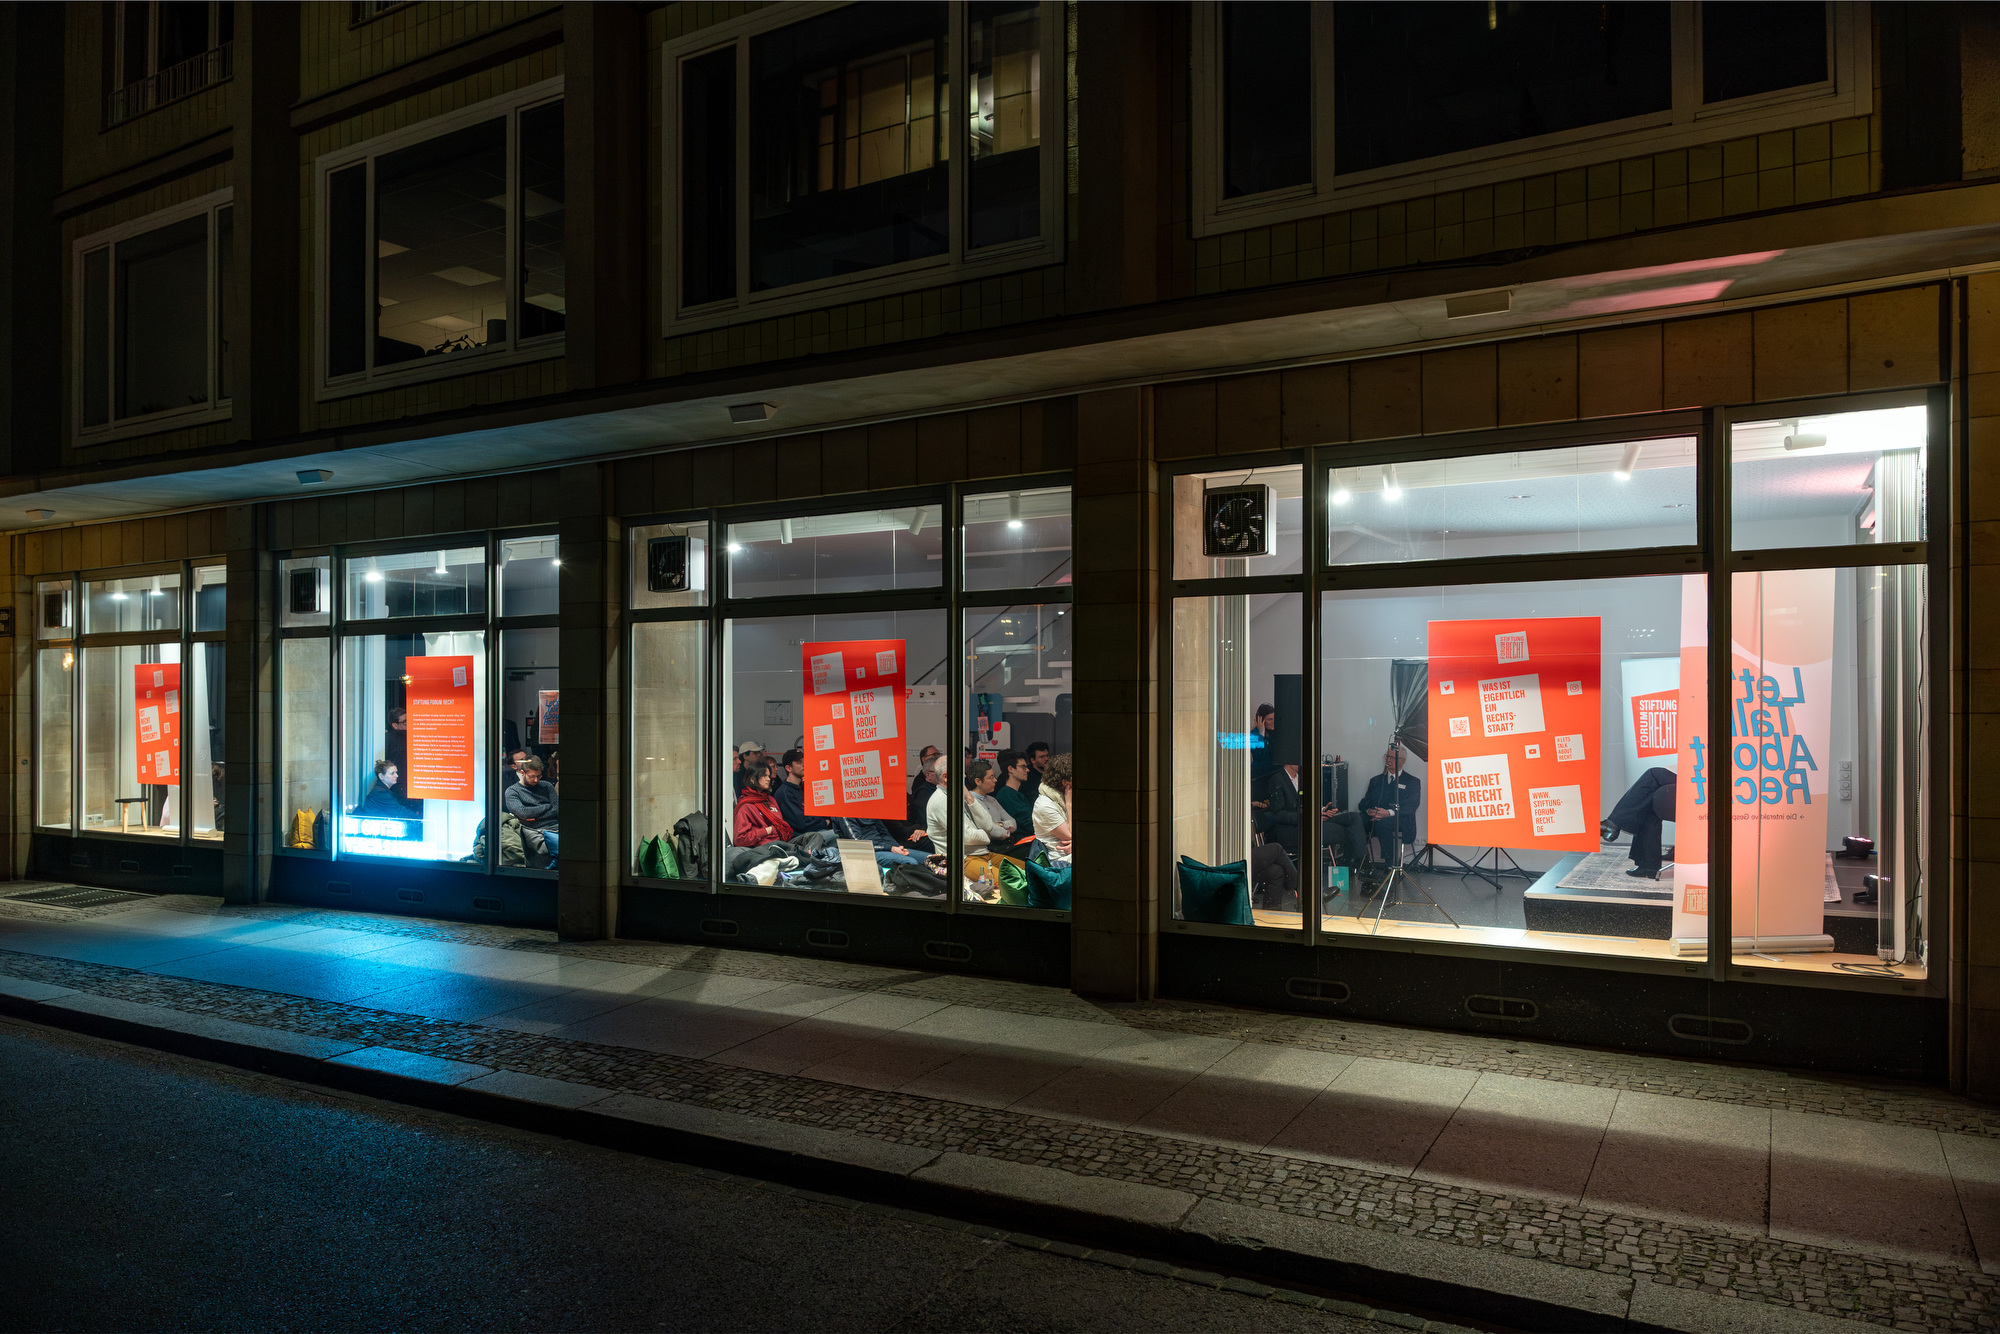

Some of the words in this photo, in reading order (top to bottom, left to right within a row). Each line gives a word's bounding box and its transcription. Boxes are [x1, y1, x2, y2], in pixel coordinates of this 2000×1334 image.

[1506, 641, 1525, 659] RECHT
[1482, 682, 1499, 692] WAS
[1500, 680, 1511, 690] IST
[1483, 689, 1526, 702] EIGENTLICH
[854, 705, 871, 716] TALK
[1485, 703, 1497, 712] EIN
[1640, 699, 1677, 711] STIFTUNG
[856, 715, 877, 728] ABOUT
[1486, 712, 1517, 722] RECHTS-
[857, 727, 877, 740] RECHT
[1487, 722, 1514, 733] STAAT?
[1640, 711, 1649, 748] FORUM
[1648, 711, 1677, 749] RECHT
[842, 756, 854, 766] WER
[855, 755, 865, 764] HAT
[843, 768, 850, 777] IN
[850, 766, 867, 776] EINEM
[1444, 761, 1462, 774] WO
[844, 776, 881, 789] RECHTSSTAAT
[1446, 773, 1500, 789] BEGEGNET
[845, 790, 857, 800] DAS
[857, 788, 878, 799] SAGEN?
[1448, 791, 1467, 804] DIR
[1468, 788, 1502, 803] RECHT
[1531, 791, 1551, 799] WWW.
[1532, 799, 1563, 808] STIFTUNG-
[1450, 806, 1464, 819] IM
[1466, 803, 1511, 818] ALLTAG?
[1534, 808, 1557, 816] FORUM-
[1535, 816, 1556, 824] RECHT.
